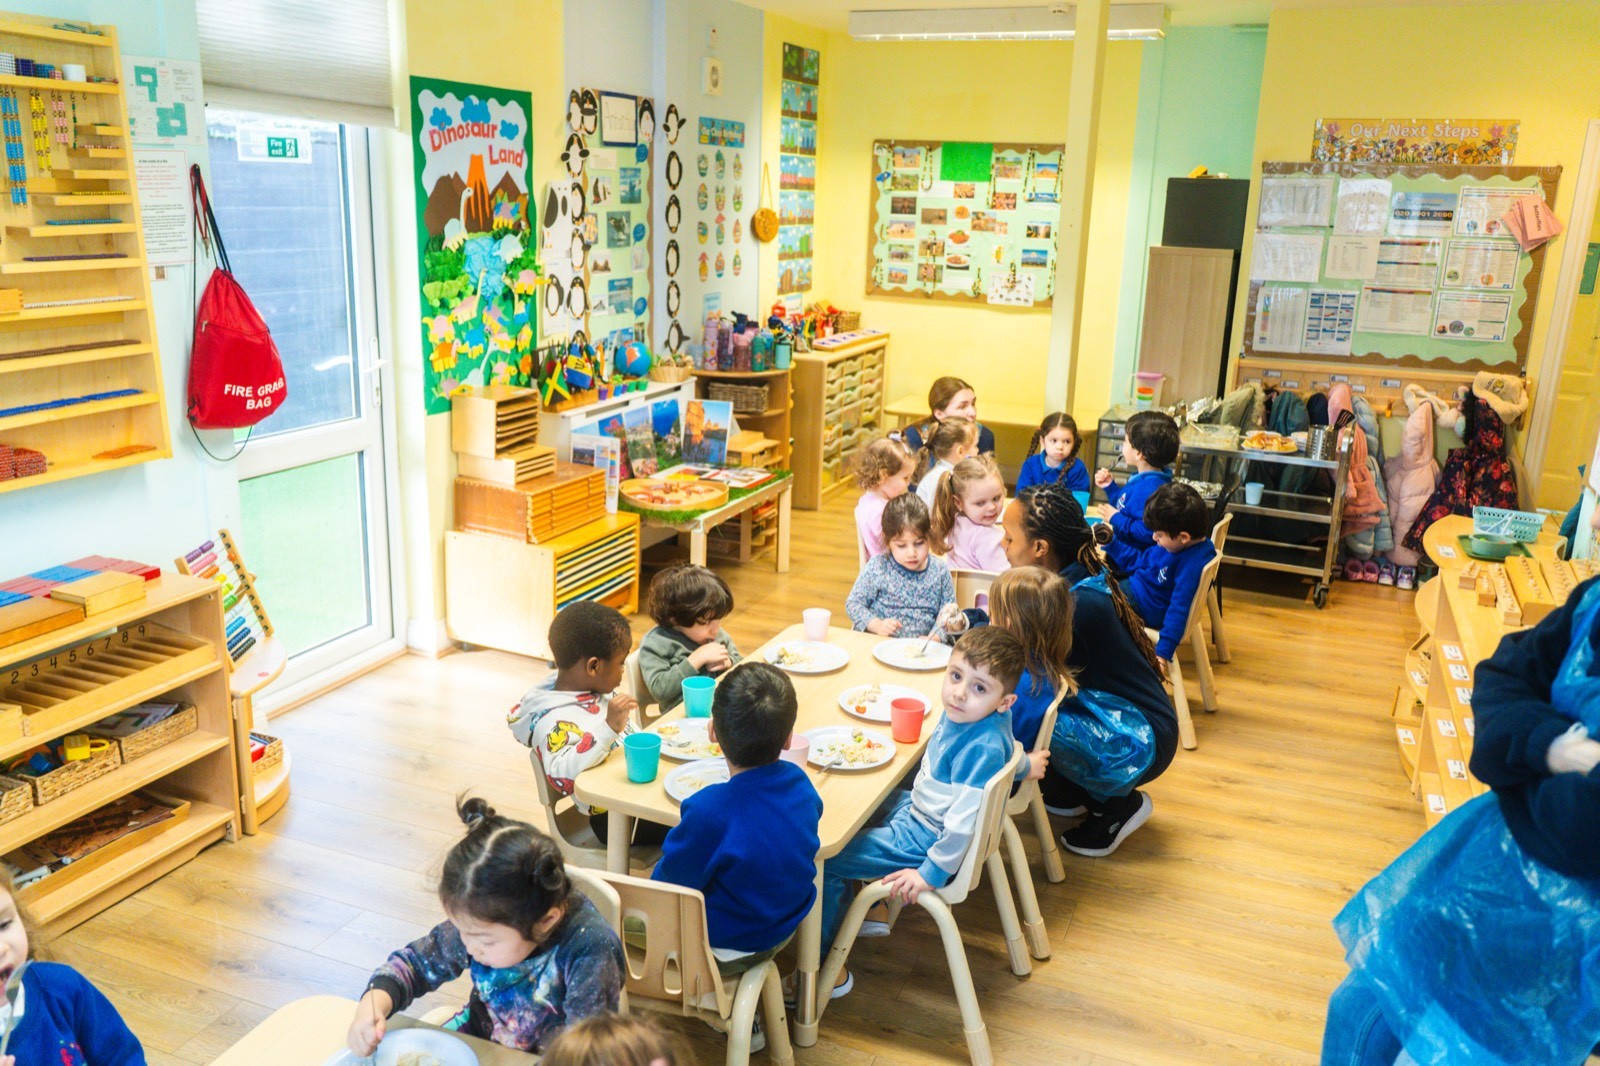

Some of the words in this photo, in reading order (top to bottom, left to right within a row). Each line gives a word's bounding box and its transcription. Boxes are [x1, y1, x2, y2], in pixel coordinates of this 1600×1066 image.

[429, 122, 498, 152] Dinosaur
[1350, 123, 1382, 138] Our
[1387, 123, 1427, 138] Next
[1433, 123, 1480, 140] Steps
[270, 139, 283, 147] Fire
[271, 148, 283, 156] exit
[488, 144, 524, 168] Land
[224, 384, 253, 397] FIRE
[257, 378, 284, 396] GRAB
[246, 397, 272, 410] BAG
[11, 671, 19, 684] 2
[31, 664, 39, 676] 3
[50, 656, 58, 668] 4
[69, 650, 77, 662] 5
[87, 643, 94, 656] 6
[105, 638, 111, 649] 7
[122, 631, 129, 643] 8
[138, 625, 145, 637] 9
